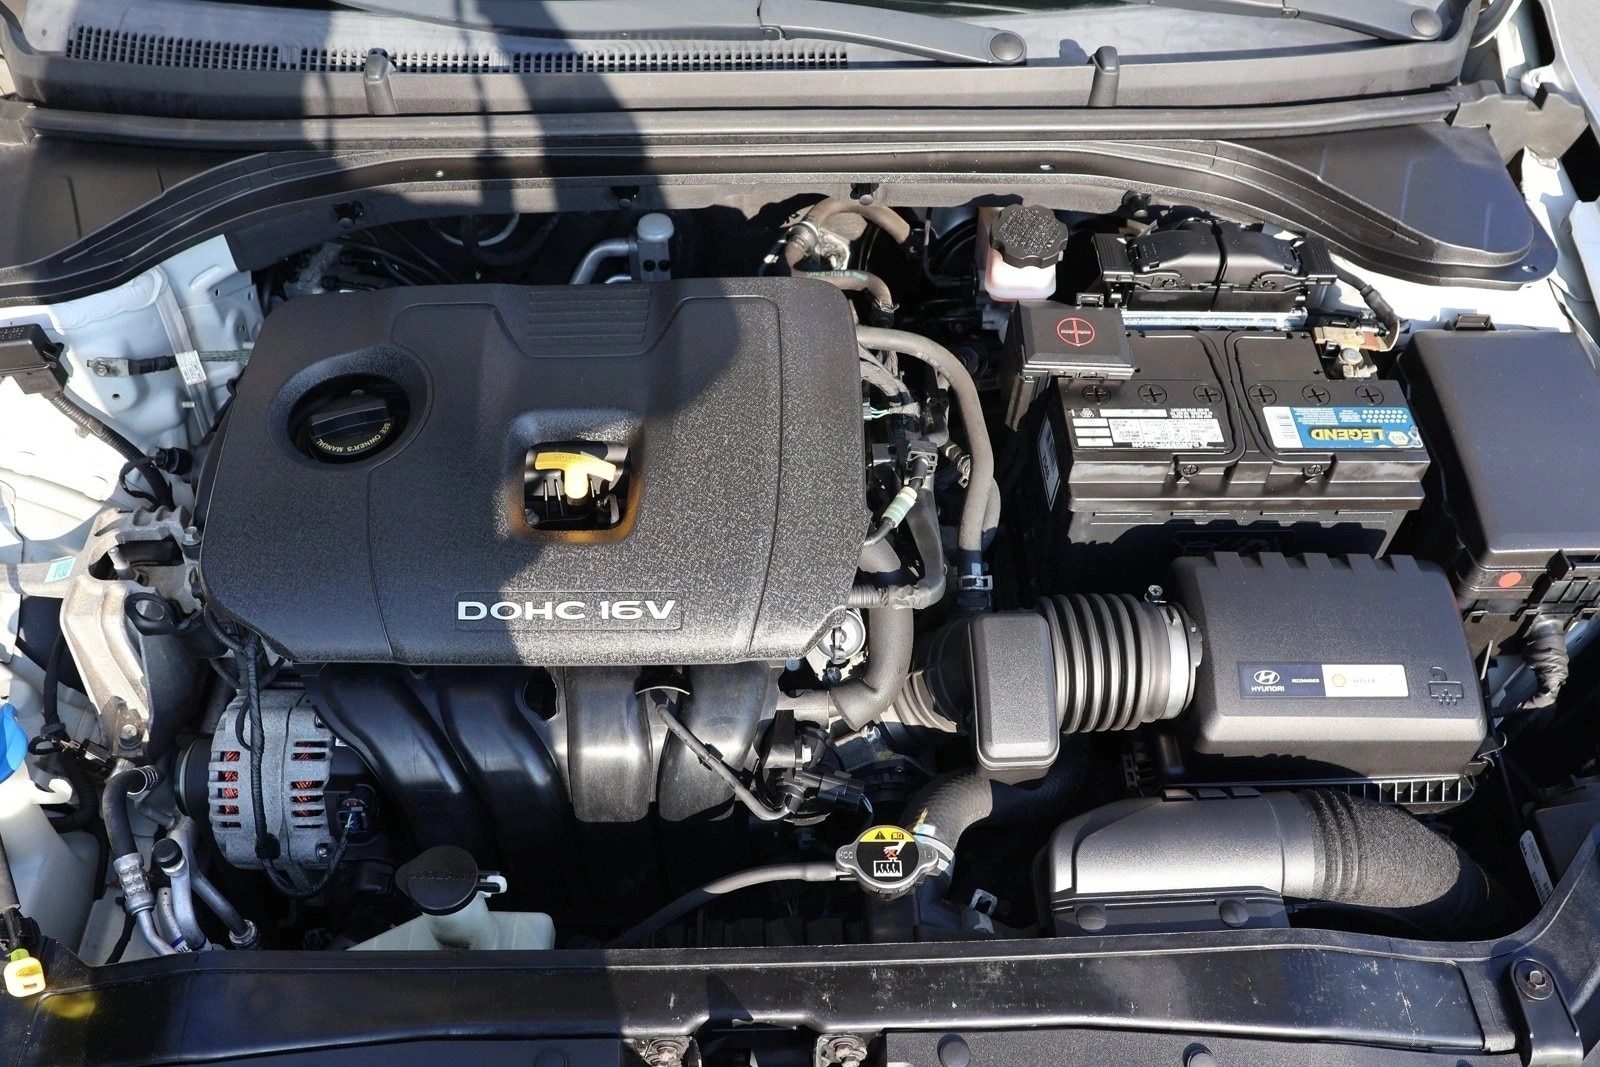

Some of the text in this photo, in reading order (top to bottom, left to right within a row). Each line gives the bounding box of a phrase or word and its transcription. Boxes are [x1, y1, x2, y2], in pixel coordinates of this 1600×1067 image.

[316, 422, 391, 453] SEE OWNER'S MANUAL
[1311, 428, 1385, 441] LEGEND
[457, 600, 676, 619] DOHC 16V
